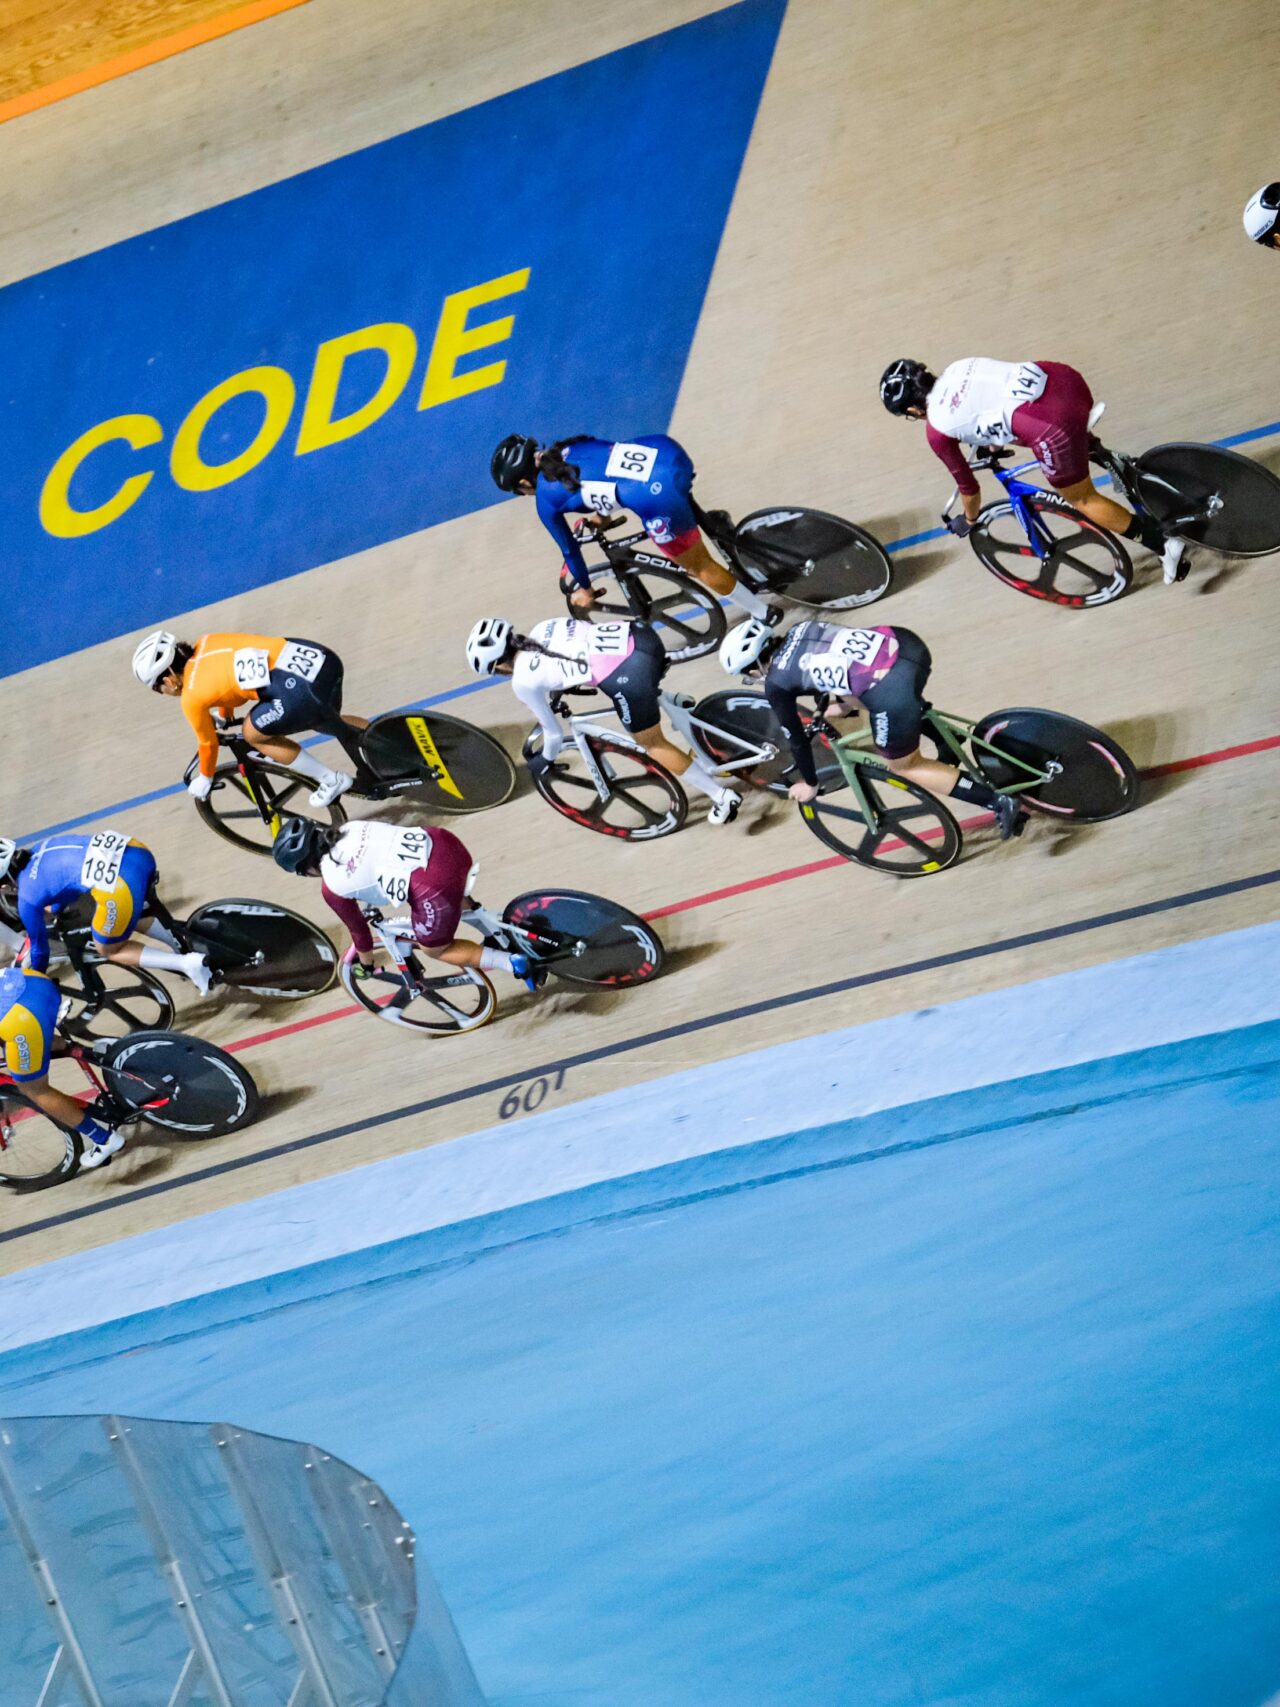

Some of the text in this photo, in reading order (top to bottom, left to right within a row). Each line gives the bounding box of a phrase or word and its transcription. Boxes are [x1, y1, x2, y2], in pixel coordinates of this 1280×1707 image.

[38, 267, 532, 538] CODE
[620, 450, 647, 473] 56
[590, 493, 614, 511] 56
[595, 624, 621, 652] 116
[842, 631, 878, 660] 332
[236, 656, 267, 682] 235
[287, 647, 319, 677] 235
[812, 666, 847, 689] 332
[92, 833, 124, 851] 185
[397, 832, 427, 861] 148
[85, 858, 118, 885] 185
[377, 875, 407, 901] 148
[102, 899, 117, 934] JALISCO
[14, 1034, 30, 1070] JALISCO
